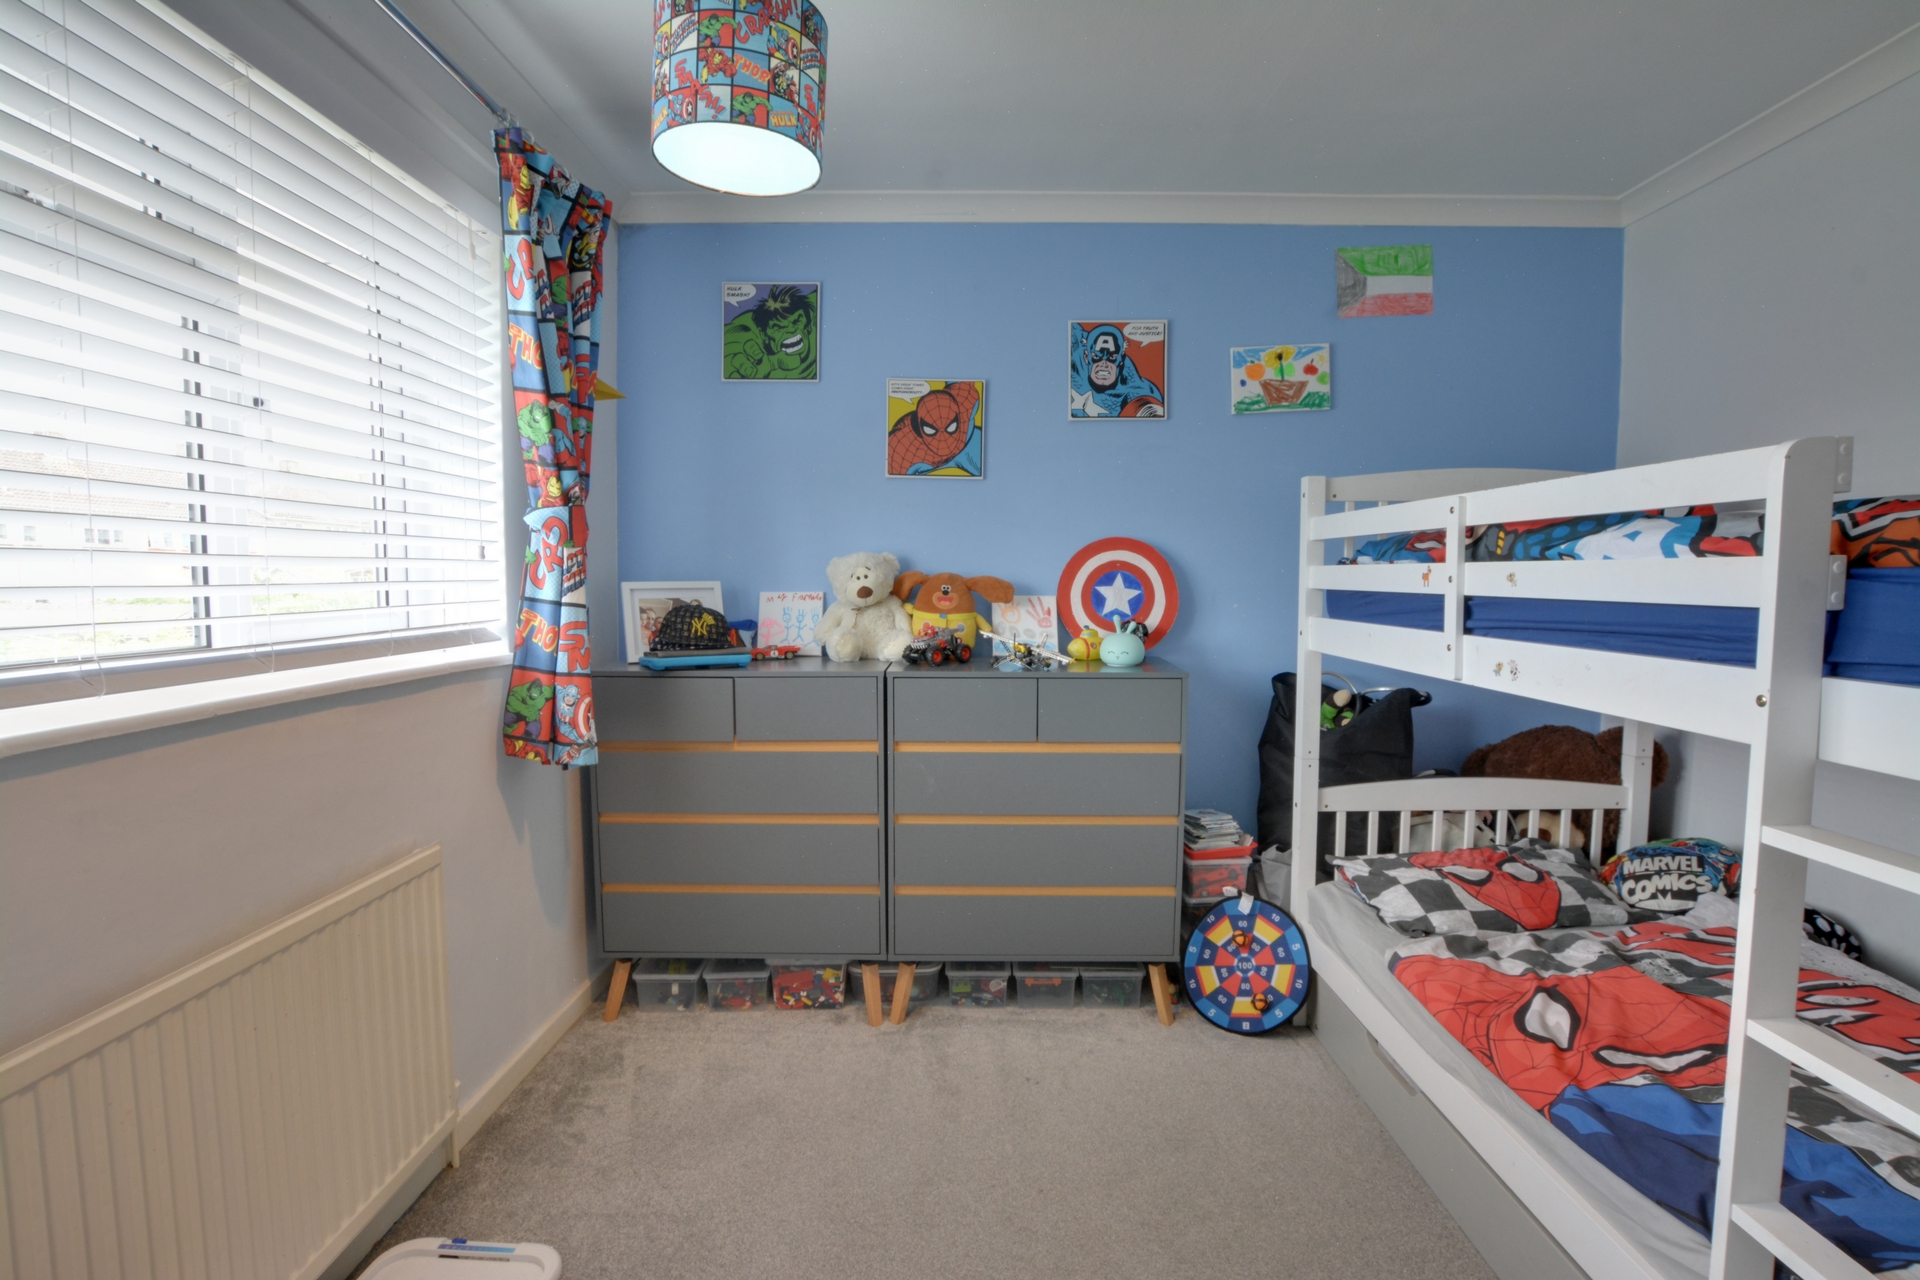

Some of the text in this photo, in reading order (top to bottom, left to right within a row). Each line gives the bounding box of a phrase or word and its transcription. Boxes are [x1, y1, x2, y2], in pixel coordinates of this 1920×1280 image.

[733, 53, 771, 85] THOR
[674, 58, 726, 120] SMASH!
[770, 115, 797, 127] HULK
[520, 608, 559, 657] THO
[1623, 855, 1704, 875] MARVEL
[1621, 873, 1713, 905] COMICS
[1206, 914, 1216, 924] 10
[1271, 913, 1281, 923] 10
[1238, 920, 1248, 928] 60
[1251, 942, 1261, 952] 80
[1291, 943, 1301, 951] 5
[1203, 949, 1212, 959] 60
[1237, 962, 1253, 970] 100
[1220, 967, 1229, 978] 80
[1189, 979, 1197, 989] 10
[1241, 982, 1251, 990] 80
[1295, 979, 1304, 989] 10
[1217, 994, 1228, 1004] 60
[1207, 1008, 1217, 1017] 5
[1274, 1008, 1284, 1018] 5
